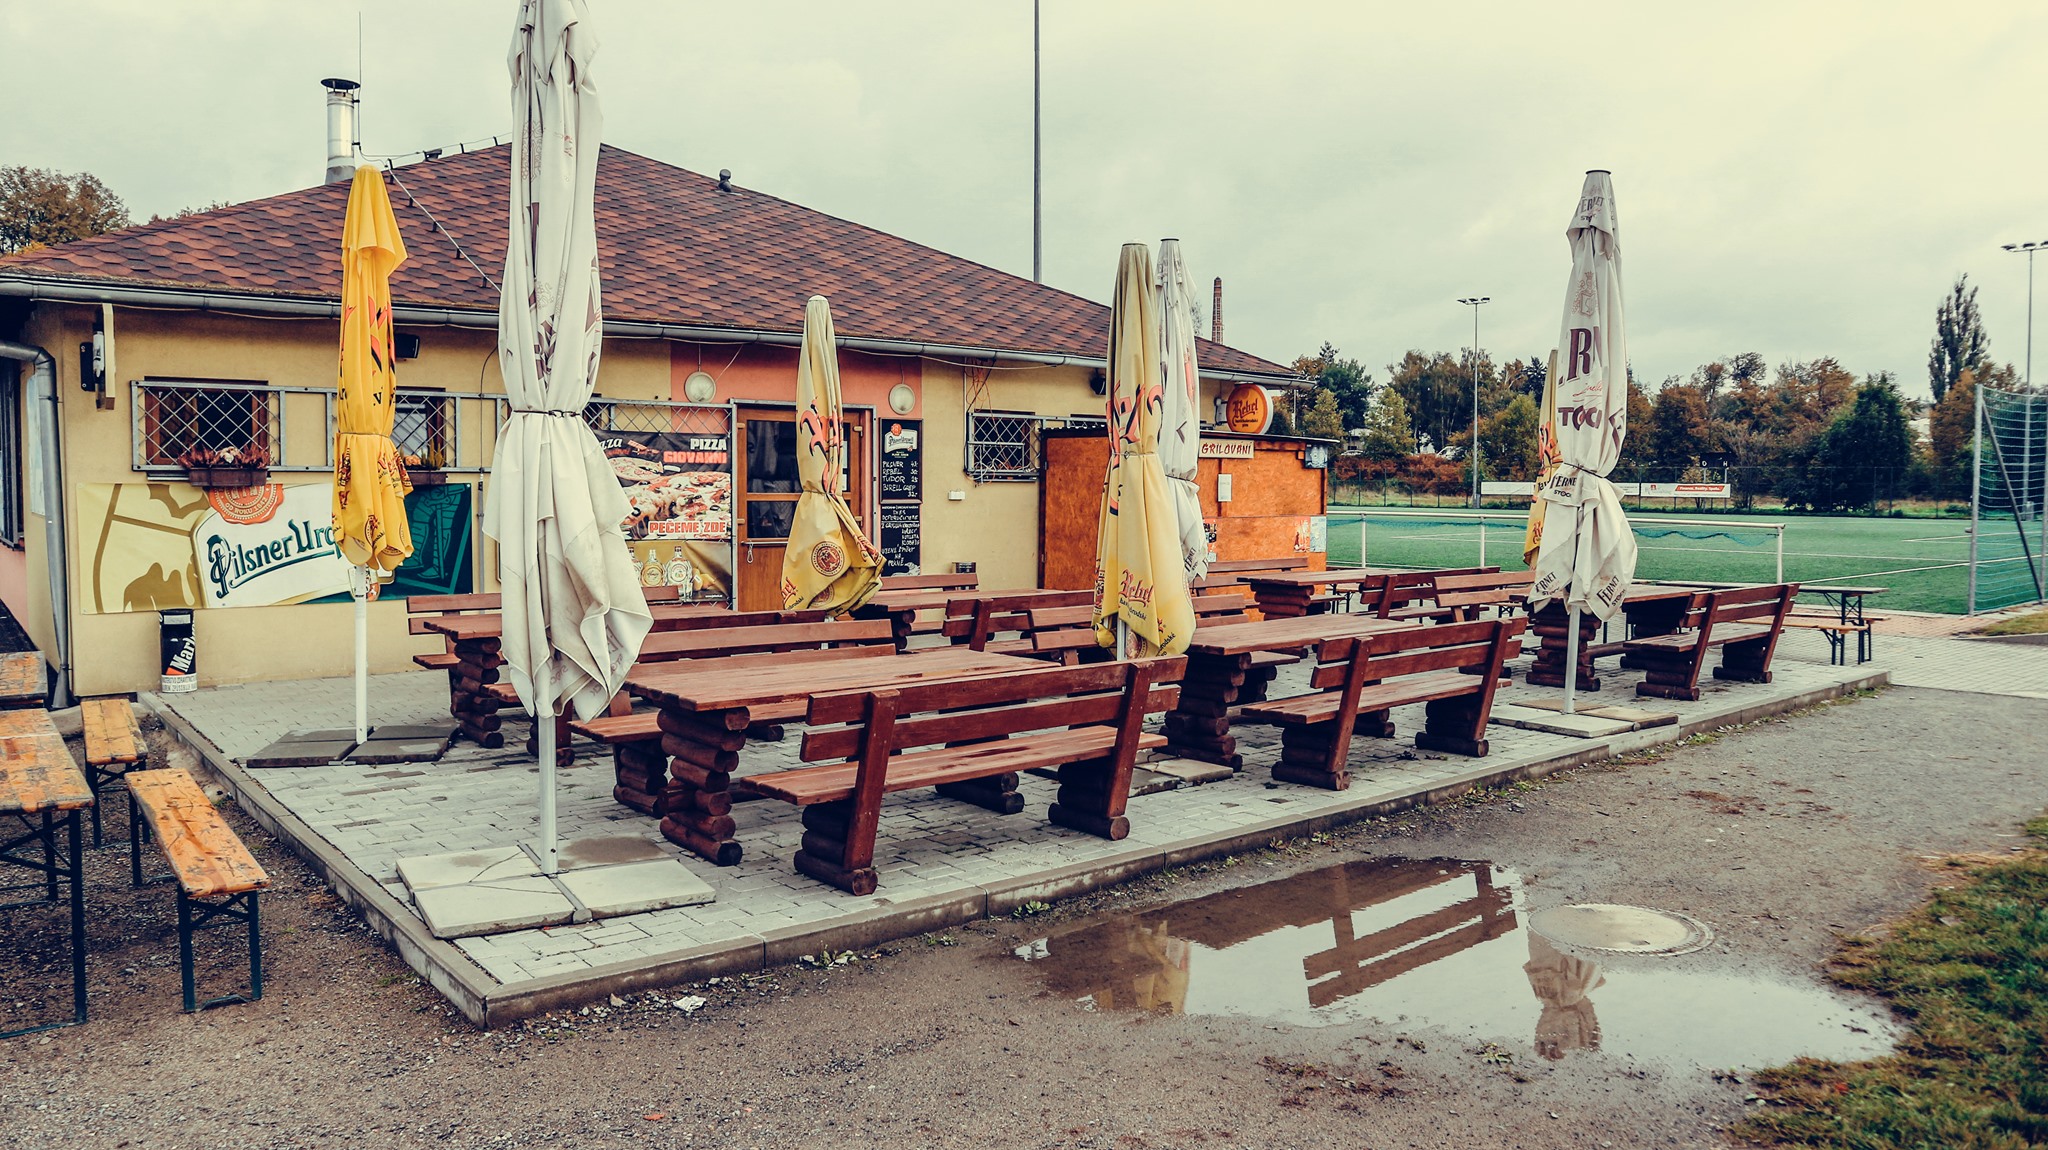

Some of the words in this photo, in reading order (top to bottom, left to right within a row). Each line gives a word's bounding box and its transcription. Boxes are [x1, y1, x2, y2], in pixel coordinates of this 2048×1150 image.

[1232, 398, 1258, 419] Rebel
[690, 438, 727, 451] PIZZA
[663, 451, 727, 464] GIOVANNI
[882, 475, 906, 484] TUDOR
[649, 519, 700, 534] PEČEME
[703, 521, 727, 534] ZDE
[206, 534, 294, 599] Pilsner
[1596, 574, 1621, 608] FERNET
[1611, 588, 1627, 607] STOCK
